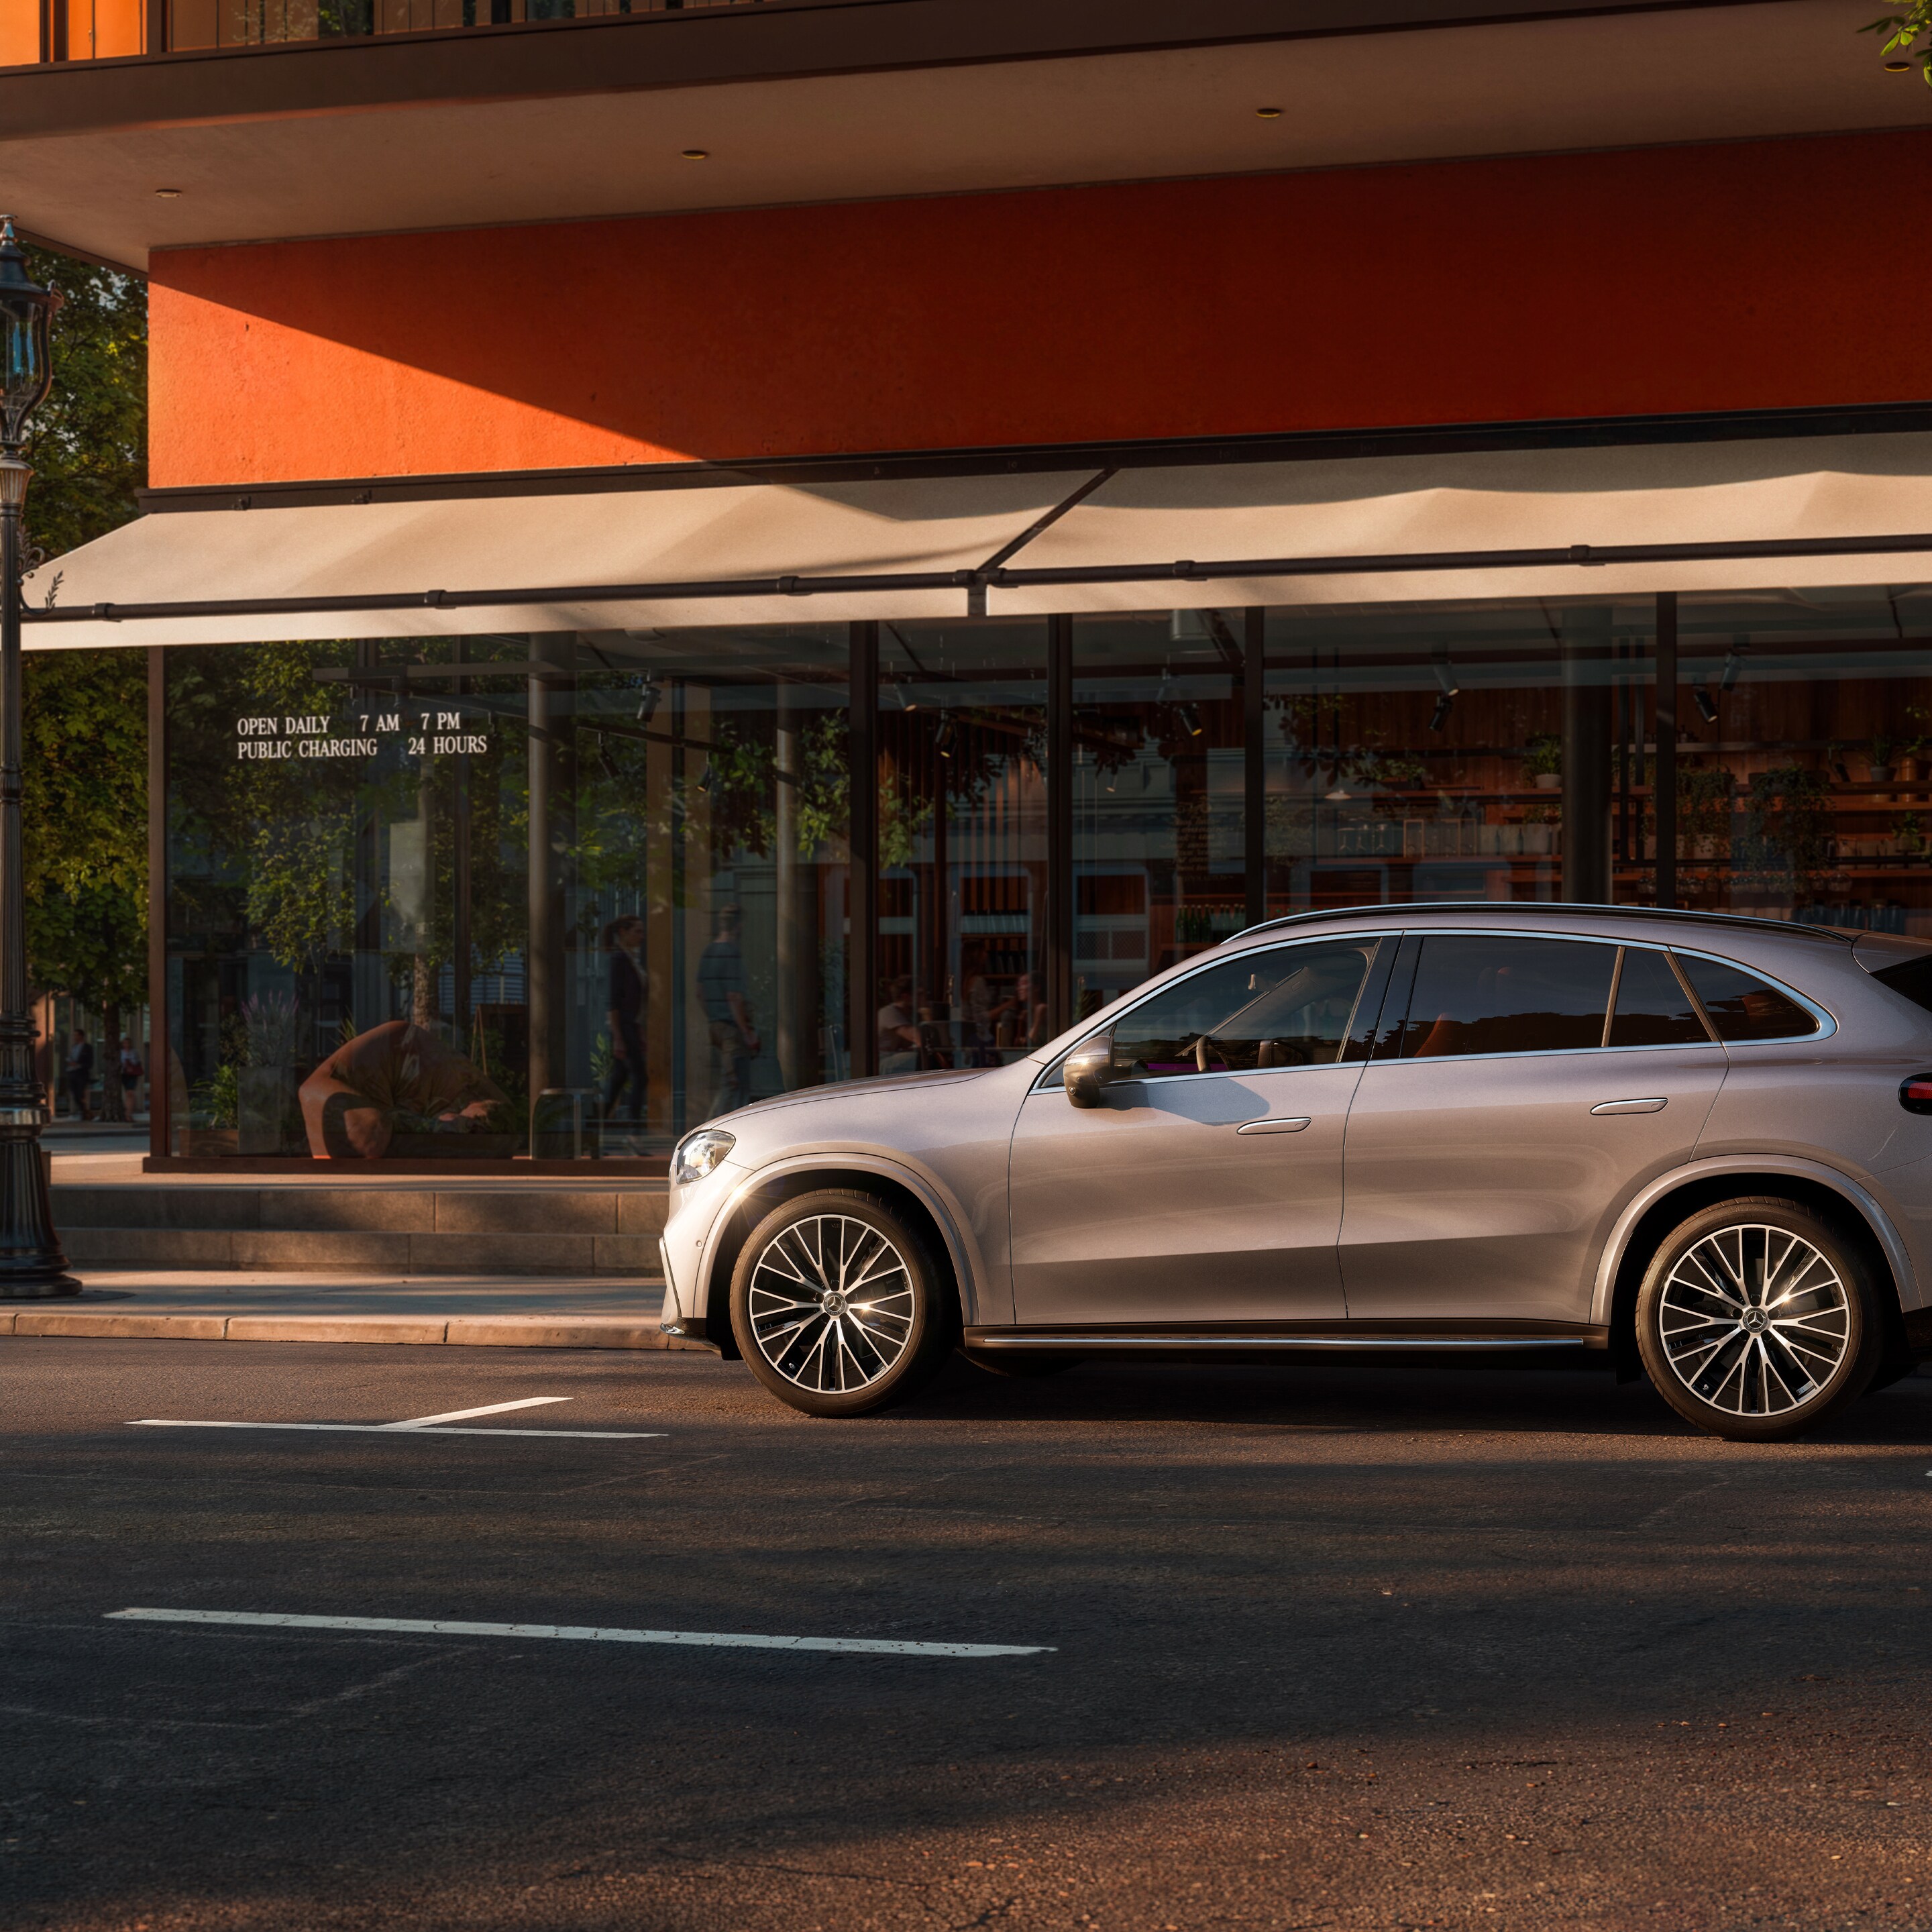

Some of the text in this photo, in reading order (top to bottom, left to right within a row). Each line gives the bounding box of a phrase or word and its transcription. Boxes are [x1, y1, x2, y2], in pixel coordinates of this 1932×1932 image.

[237, 712, 460, 735] OPEN DAILY 7 AM 7 PM
[237, 735, 488, 759] PUBLIC CHARGING 24 HOURS
